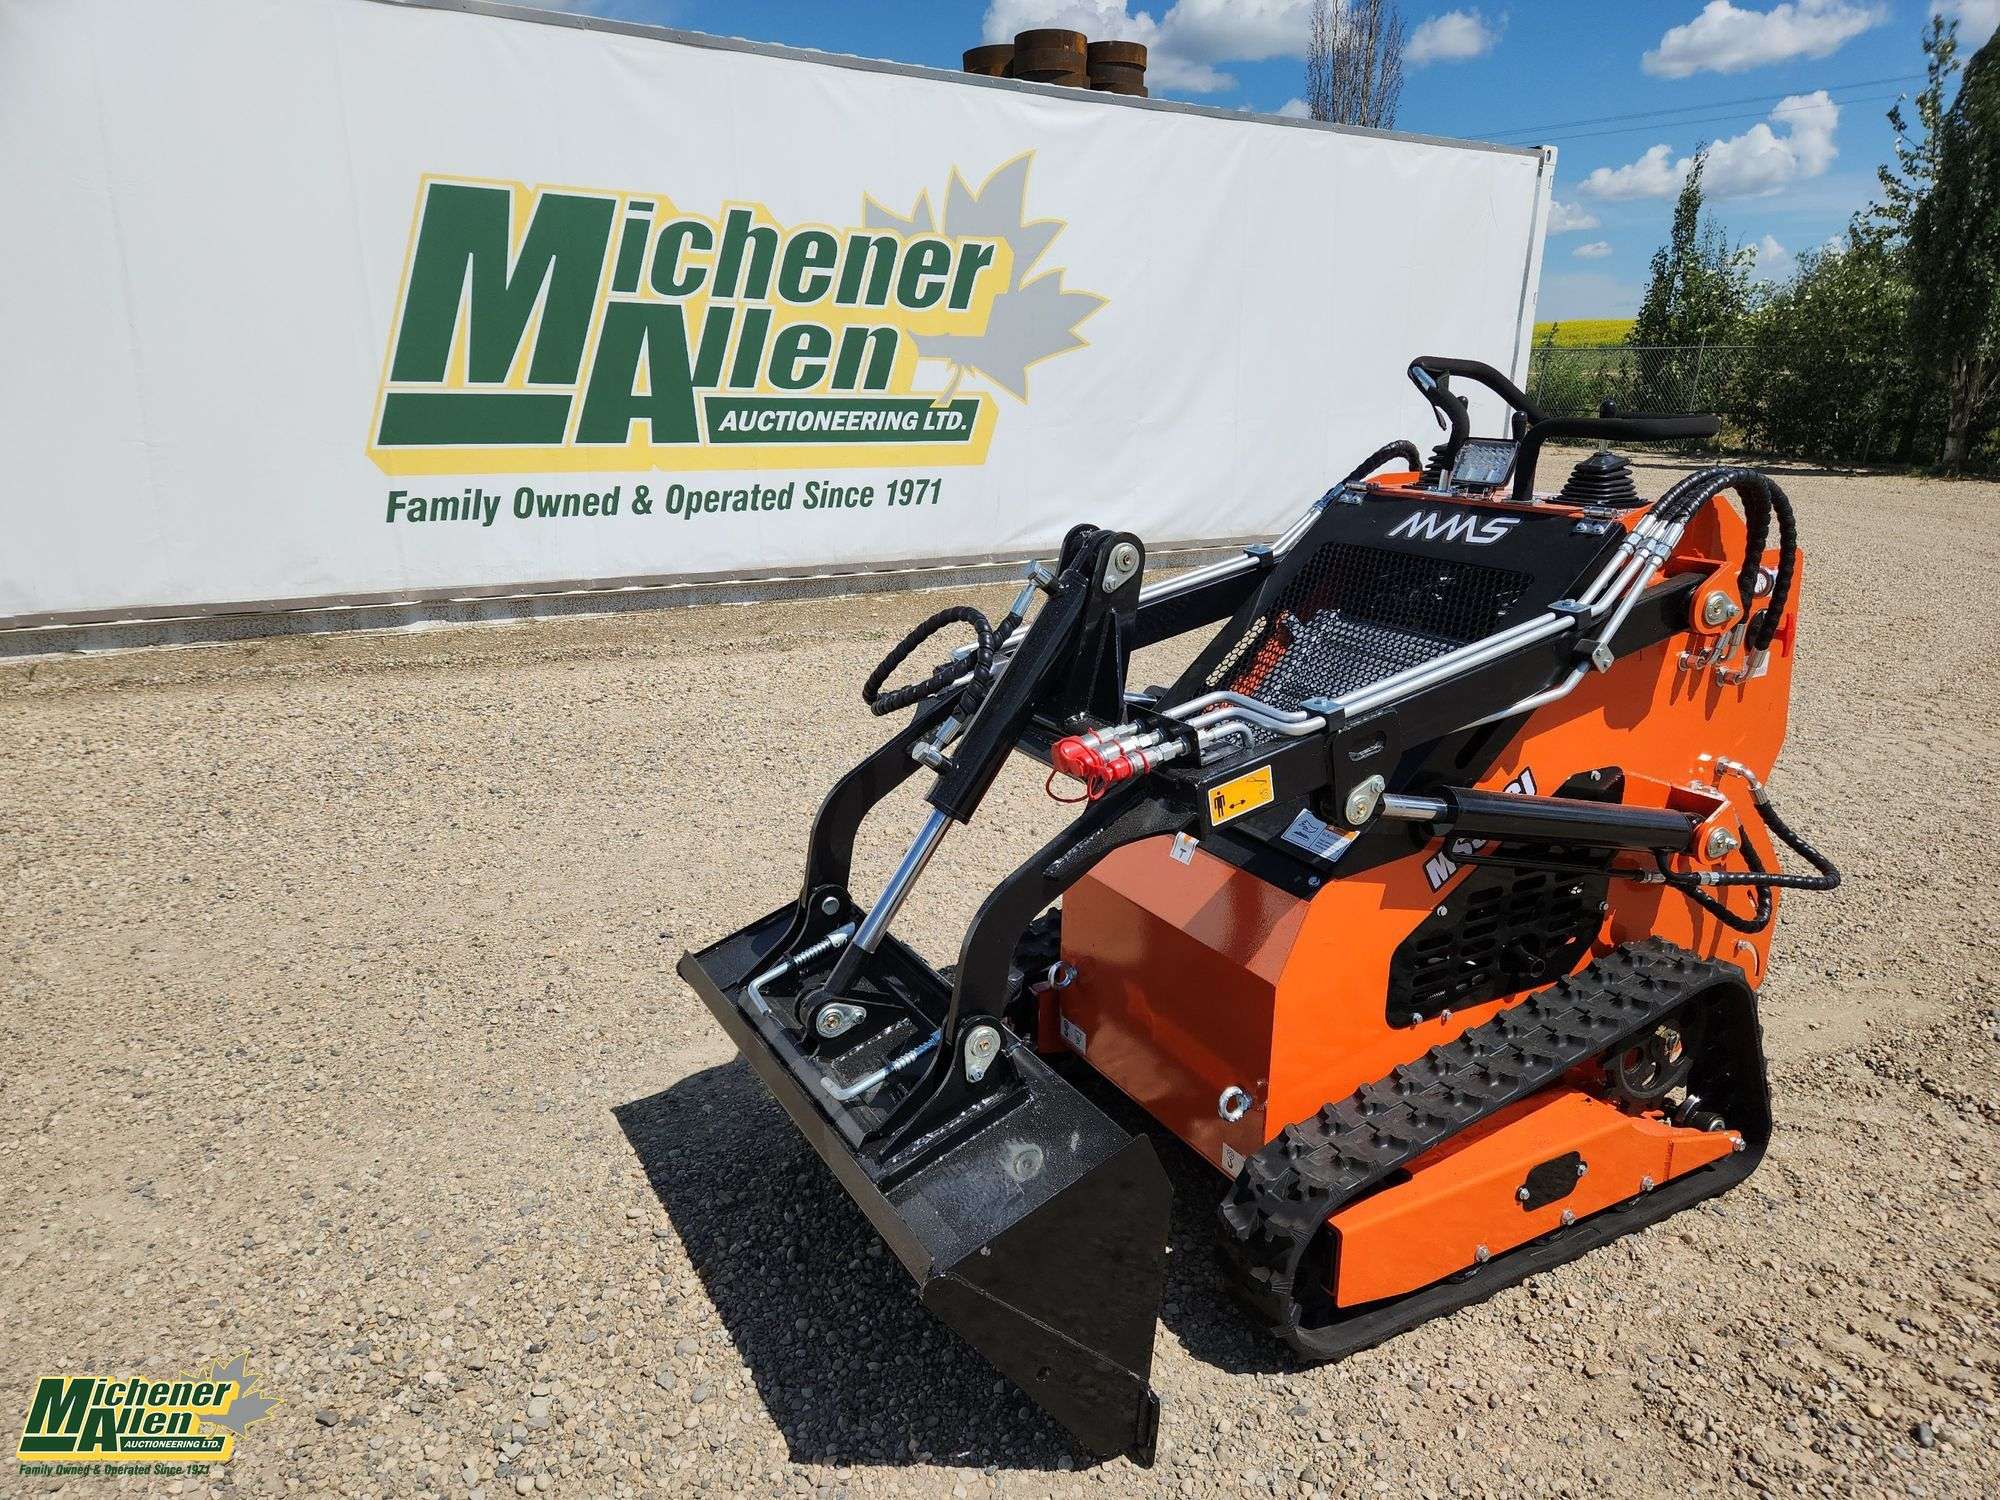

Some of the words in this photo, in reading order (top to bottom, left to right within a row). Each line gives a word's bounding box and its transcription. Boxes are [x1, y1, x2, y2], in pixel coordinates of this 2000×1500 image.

[390, 183, 994, 384] Michener
[574, 302, 899, 444] Allen
[718, 409, 919, 432] AUCTIONEERING
[922, 410, 967, 431] LTD.
[386, 488, 501, 527] Family
[513, 485, 621, 520] Owned
[631, 484, 653, 515] &
[665, 481, 795, 520] Operated
[803, 480, 874, 510] Since
[886, 477, 942, 507] 1971
